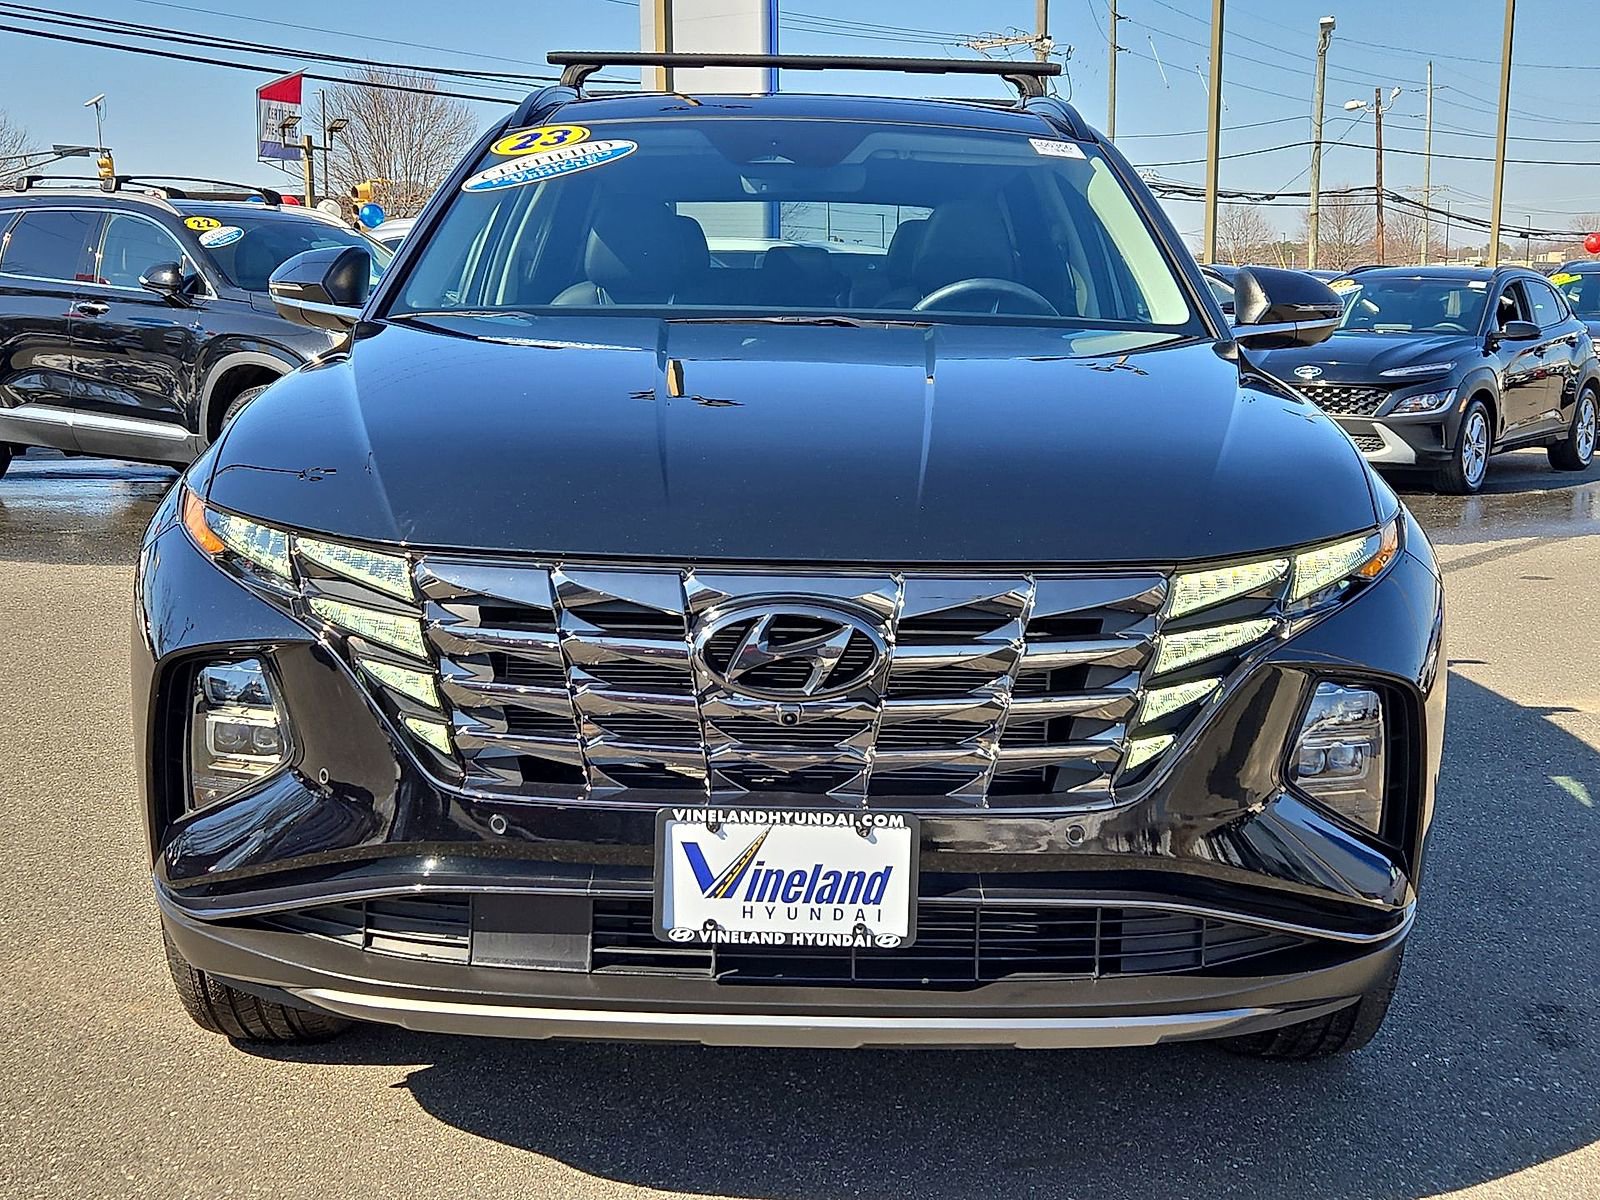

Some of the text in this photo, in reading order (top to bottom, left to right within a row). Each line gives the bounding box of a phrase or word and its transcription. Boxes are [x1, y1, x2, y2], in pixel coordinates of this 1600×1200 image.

[509, 129, 572, 151] 23
[481, 142, 613, 180] CERTIFIED
[193, 219, 214, 228] 22
[672, 808, 905, 828] VINELANDHYUNDAI.COM
[680, 824, 894, 905] Vineland
[742, 905, 882, 923] HYUNDAI
[699, 929, 872, 948] VINELAND HYUNDAI
